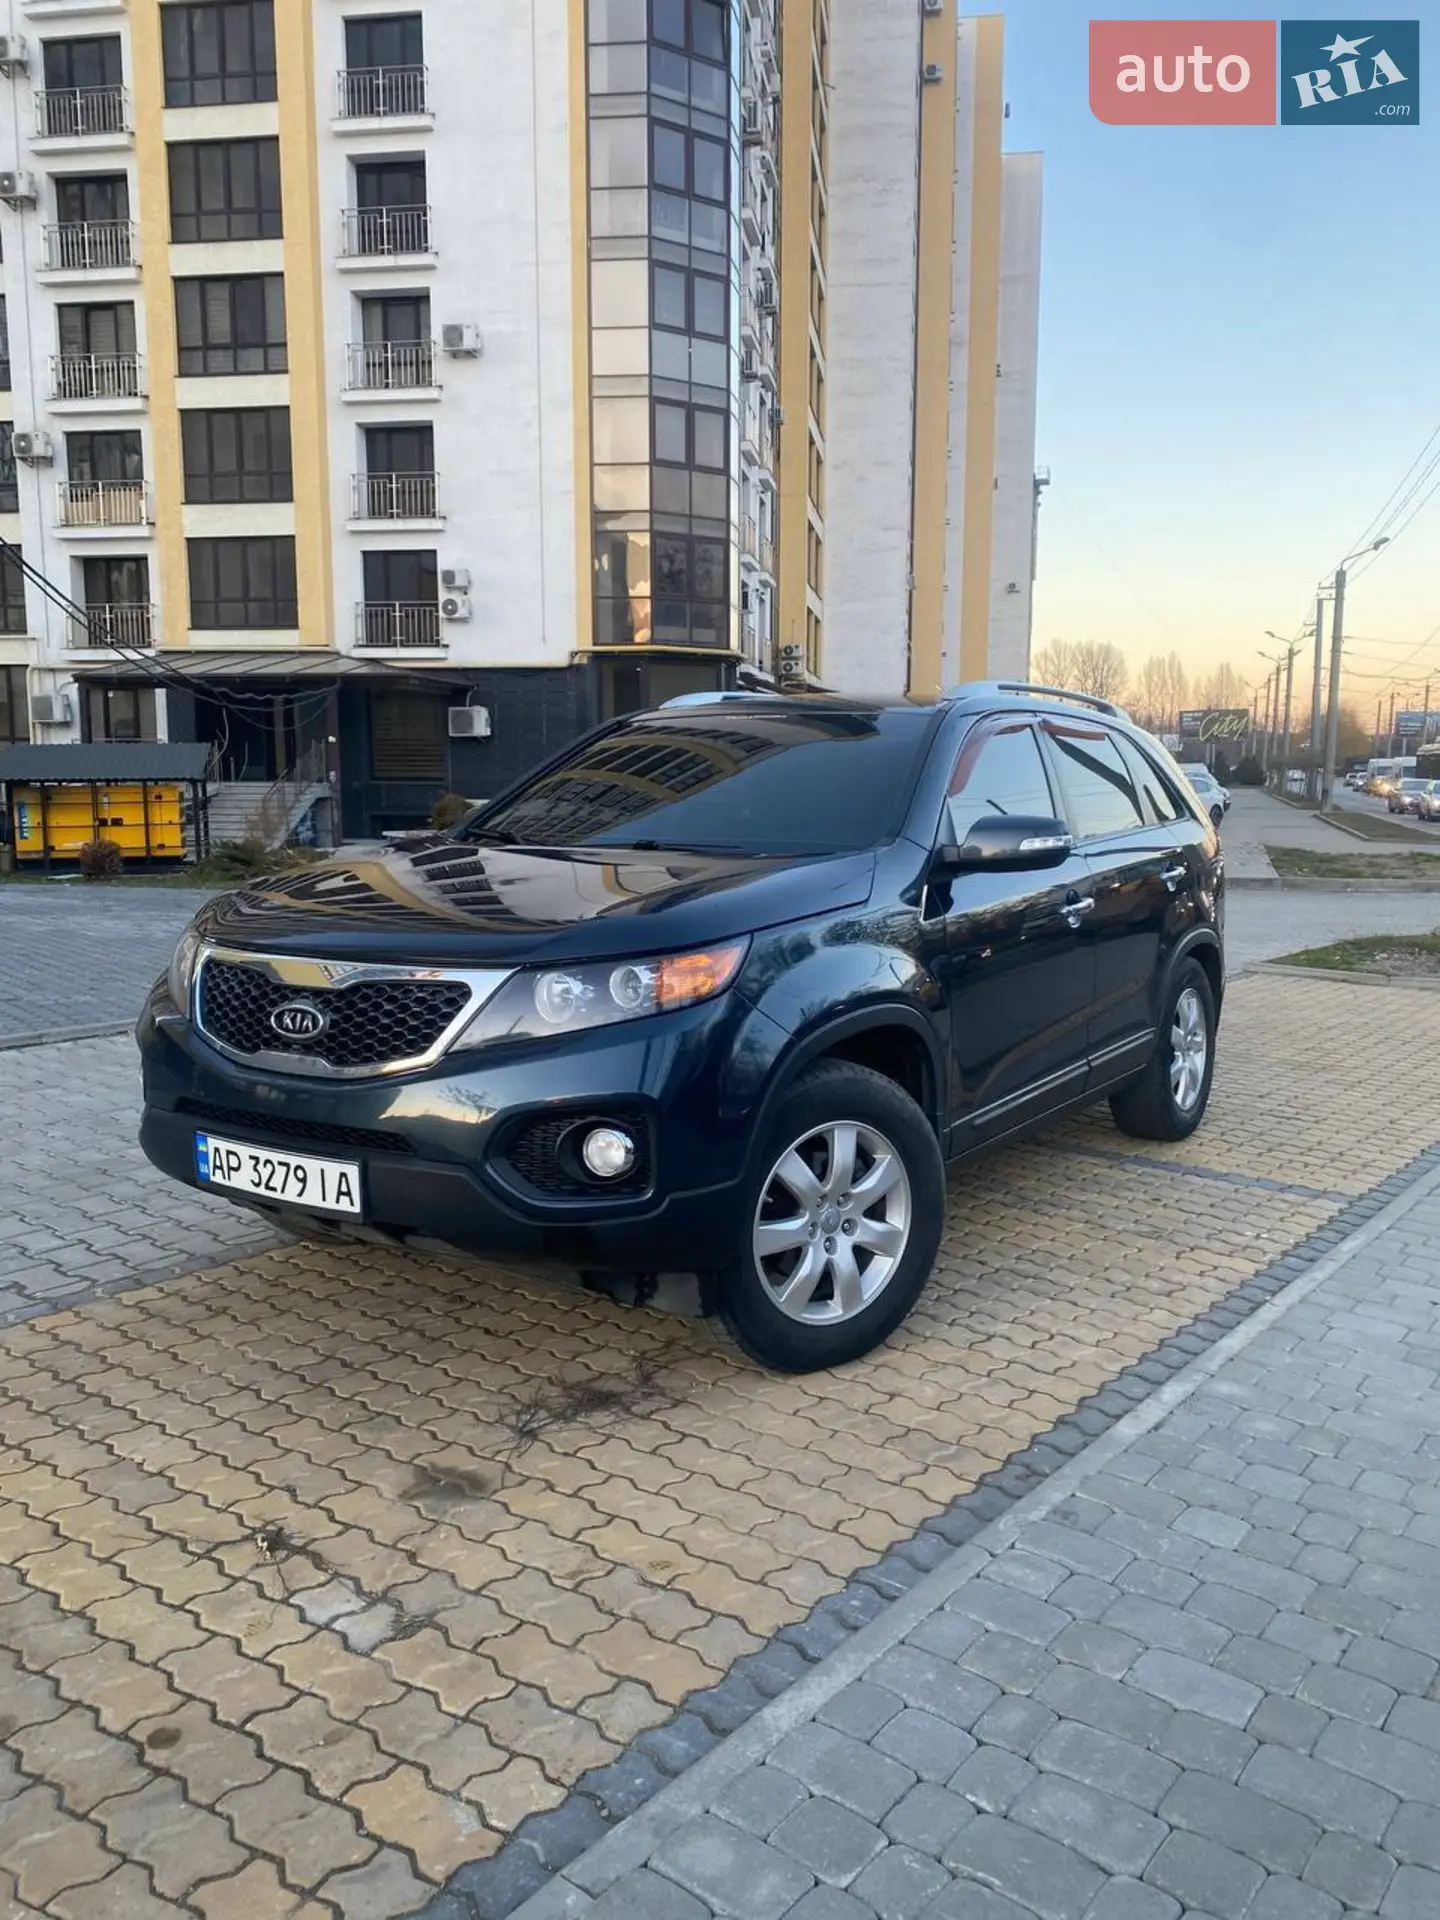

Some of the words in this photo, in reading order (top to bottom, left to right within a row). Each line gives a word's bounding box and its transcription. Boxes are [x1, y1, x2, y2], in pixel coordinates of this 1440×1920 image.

[1199, 712, 1248, 741] City
[282, 1010, 313, 1032] KIA
[212, 1146, 242, 1182] AP
[248, 1154, 307, 1198] 3279
[320, 1168, 354, 1207] IA
